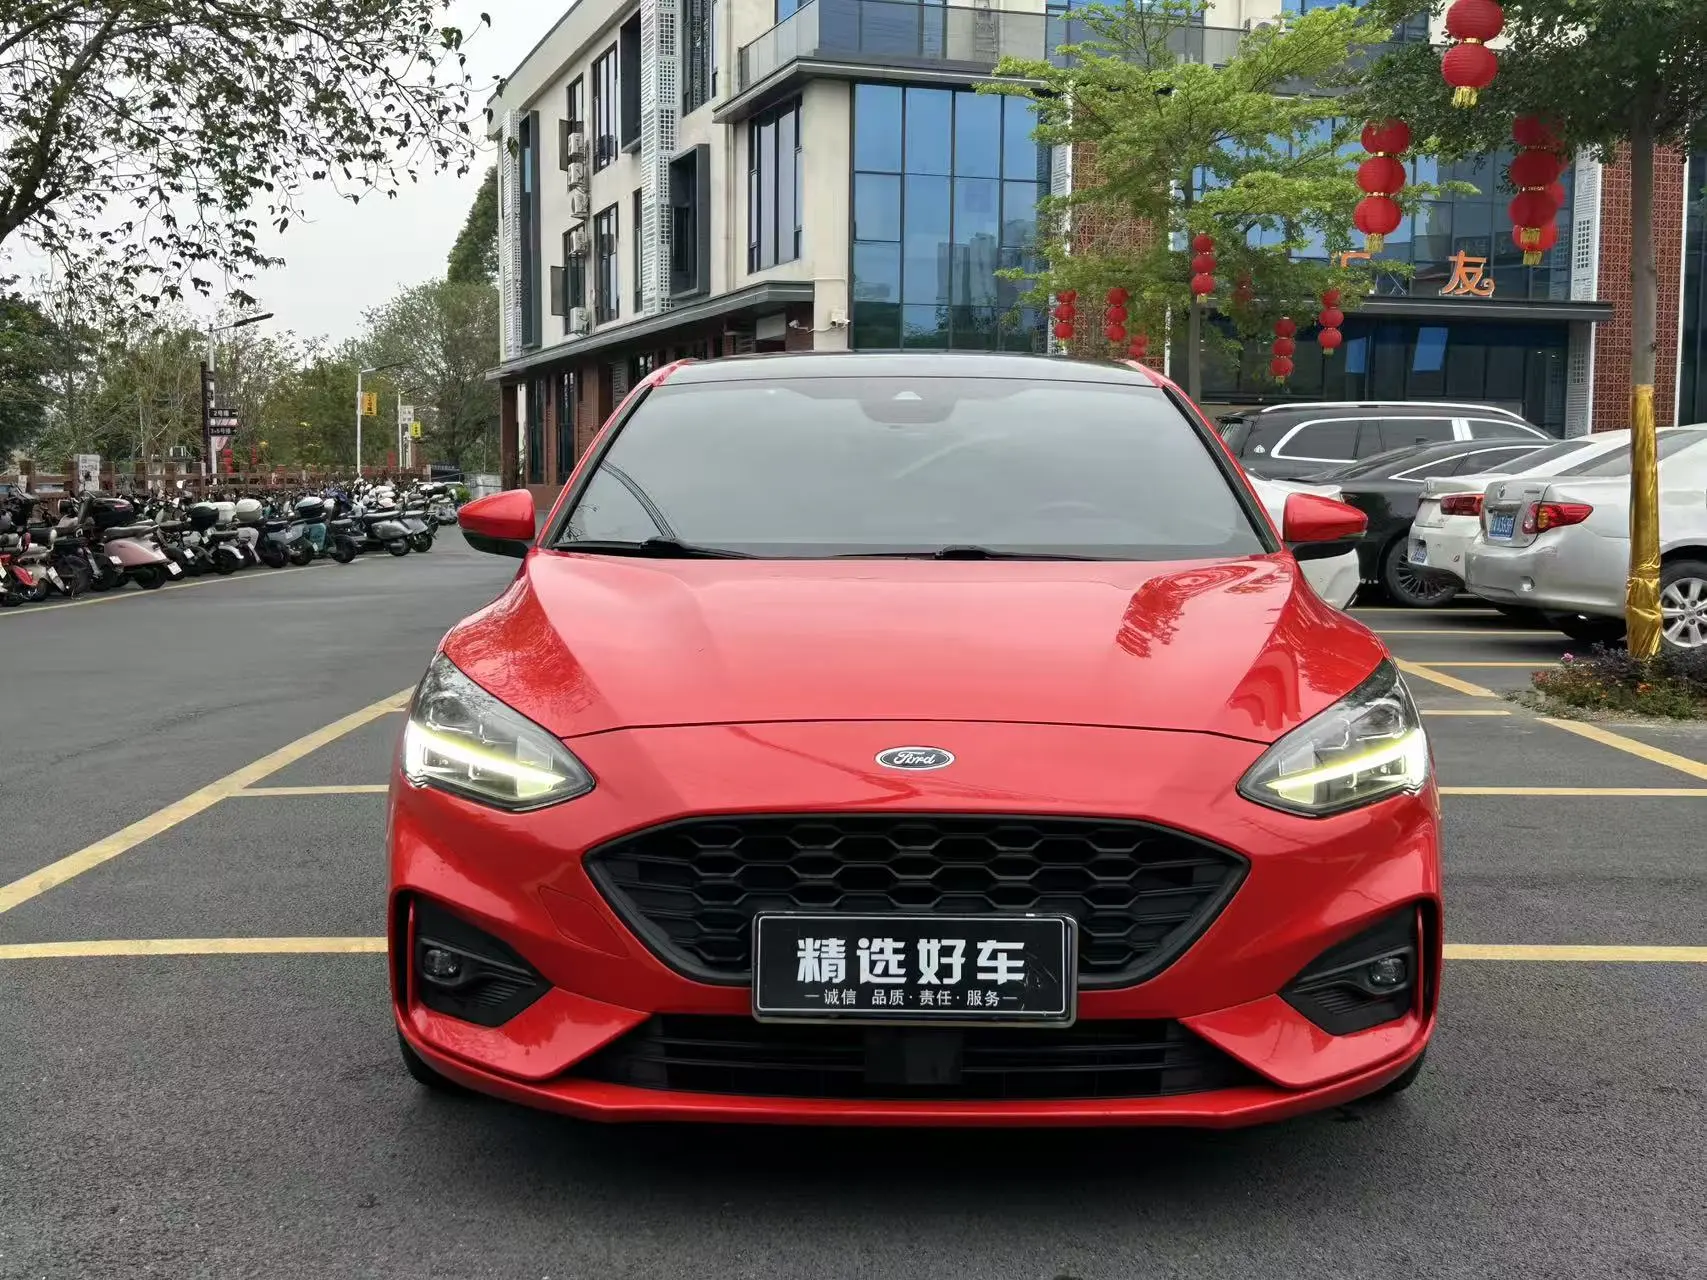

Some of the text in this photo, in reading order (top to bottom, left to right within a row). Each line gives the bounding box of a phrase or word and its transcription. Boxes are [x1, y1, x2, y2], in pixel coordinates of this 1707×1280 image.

[893, 751, 936, 765] Ford
[796, 937, 1025, 985] 精选好车
